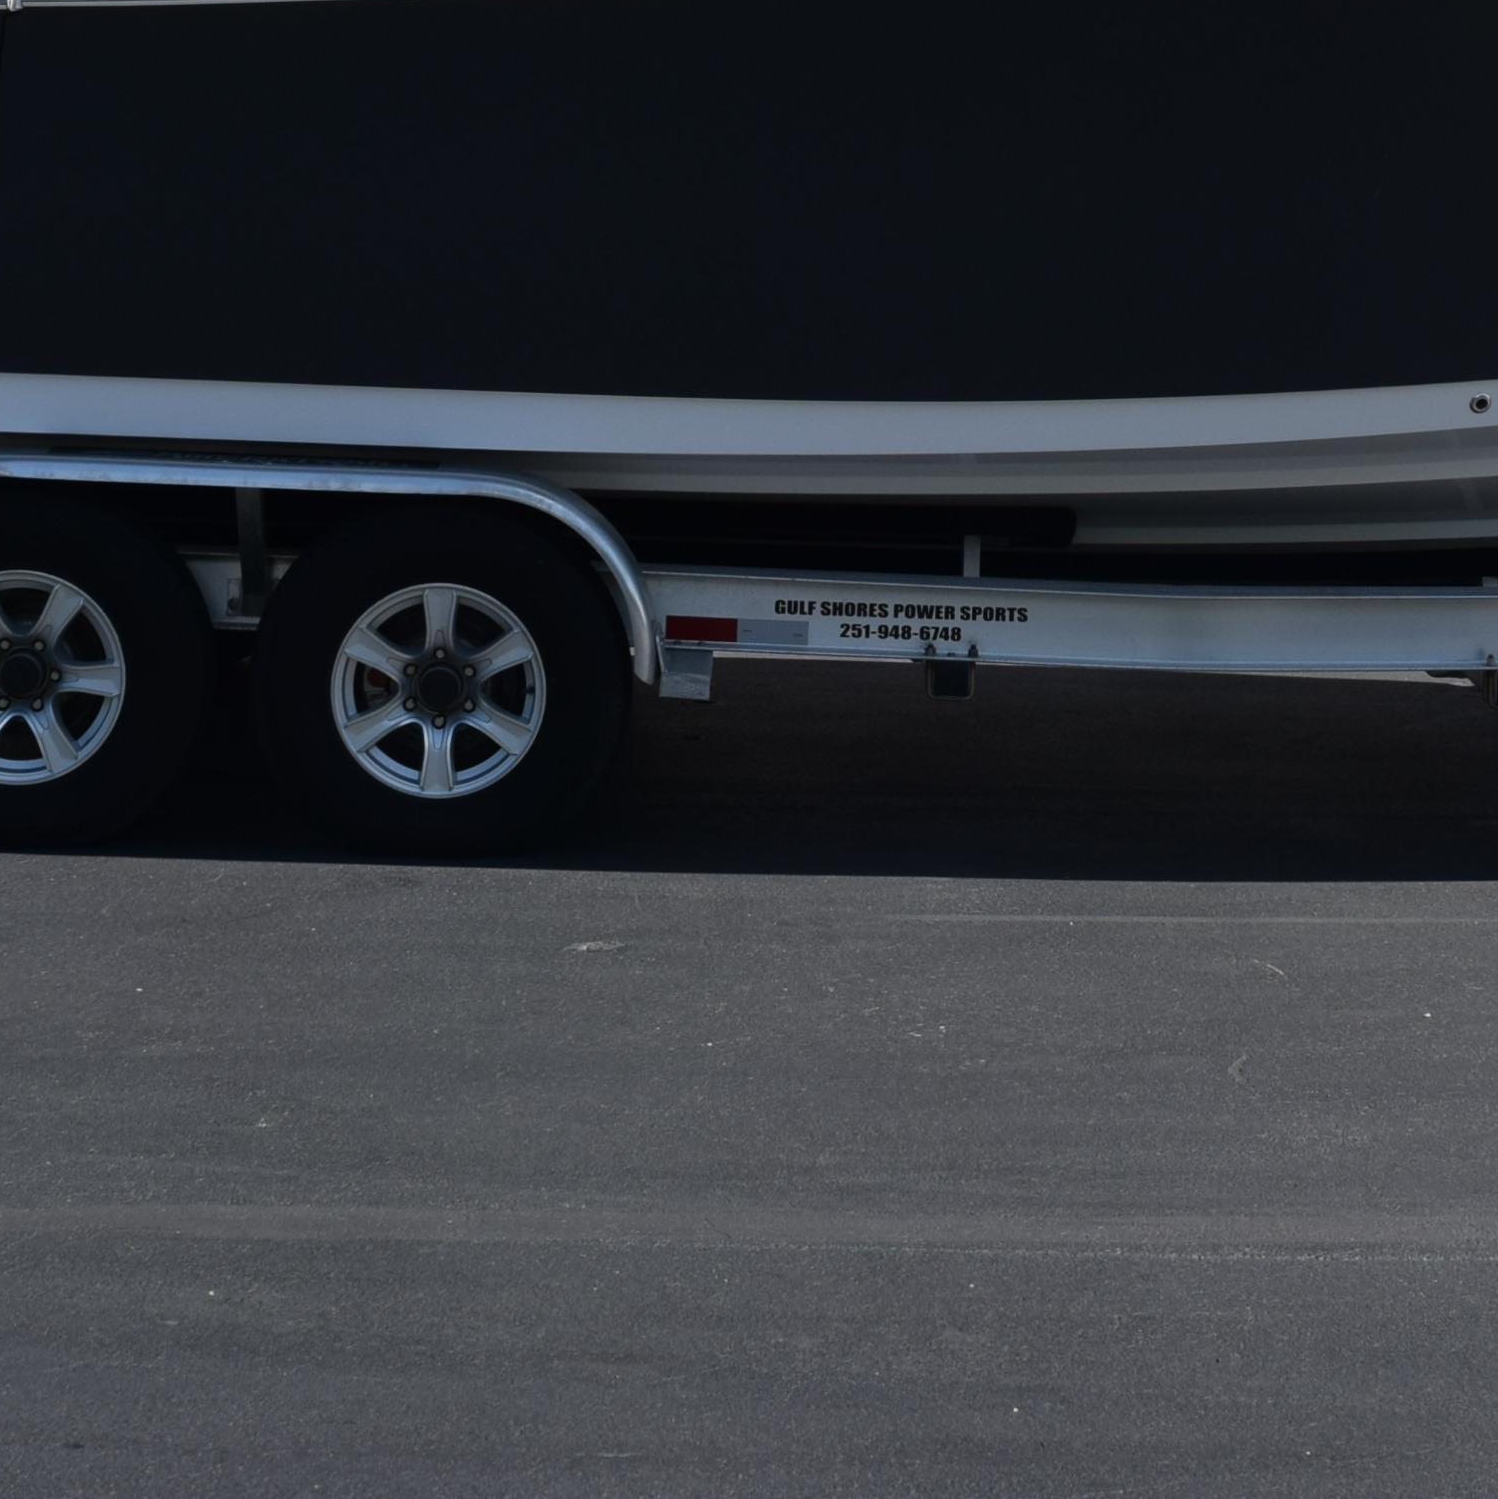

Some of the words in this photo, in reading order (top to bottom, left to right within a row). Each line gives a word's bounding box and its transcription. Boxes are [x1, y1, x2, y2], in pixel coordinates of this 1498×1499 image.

[774, 599, 817, 616] GULF
[820, 601, 889, 619] SHORES
[893, 604, 956, 621] POWER
[959, 606, 1029, 623] SPORTS
[839, 623, 963, 642] 251-948-6748
